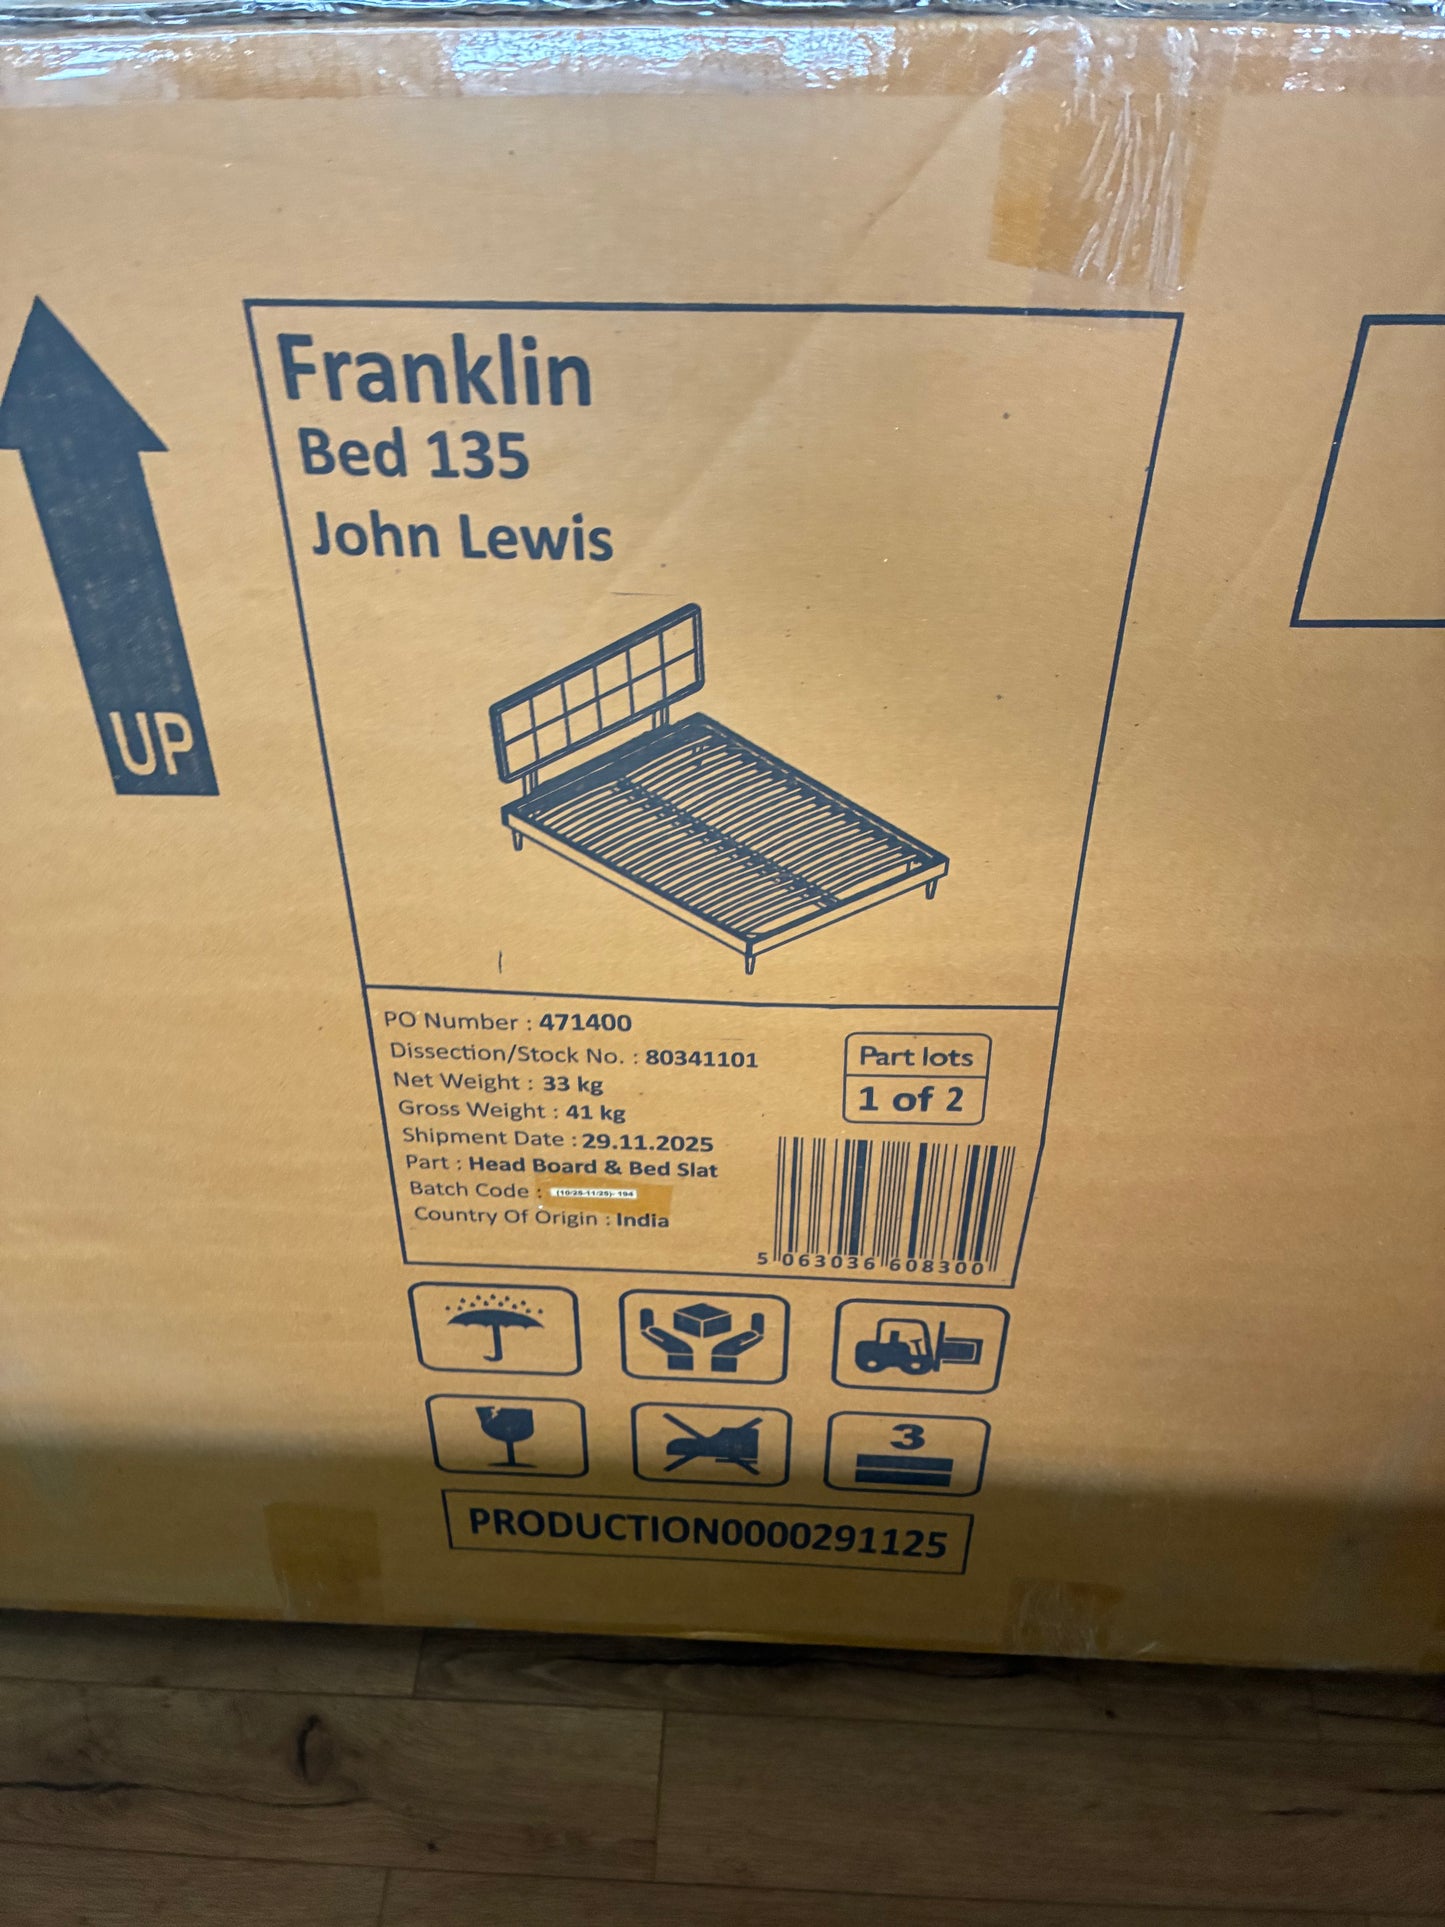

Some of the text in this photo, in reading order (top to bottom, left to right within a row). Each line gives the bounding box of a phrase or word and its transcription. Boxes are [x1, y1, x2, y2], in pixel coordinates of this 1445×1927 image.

[277, 332, 592, 406] Franklin
[298, 426, 529, 479] Bed 135
[312, 509, 614, 562] John Lewis
[109, 711, 193, 776] UP
[384, 1011, 416, 1028] PO
[424, 1012, 519, 1031] Number
[538, 1013, 632, 1033] 471400
[390, 1042, 579, 1064] Dissection/Stock
[586, 1049, 624, 1065] No.
[645, 1049, 759, 1068] 80341101
[860, 1045, 974, 1067] Part lots
[393, 1072, 434, 1089] Net
[441, 1073, 520, 1093] Weight
[542, 1075, 570, 1092] 33
[577, 1076, 604, 1096] kg
[859, 1085, 963, 1112] 1 of 2
[398, 1100, 461, 1117] Gross
[466, 1101, 546, 1122] Weight
[565, 1104, 593, 1120] 41
[600, 1104, 626, 1124] kg
[402, 1128, 508, 1149] Shipment
[514, 1131, 565, 1147] Date
[581, 1132, 714, 1152] 29.11.2025
[405, 1154, 450, 1171] Part
[469, 1155, 525, 1173] Head
[532, 1157, 598, 1175] Board
[604, 1160, 623, 1175] &
[629, 1161, 670, 1177] Bed
[677, 1161, 718, 1179] Slat
[409, 1180, 469, 1197] Batch
[475, 1182, 529, 1199] Code
[414, 1206, 497, 1226] Country
[504, 1209, 528, 1225] Of
[535, 1209, 598, 1228] Origin
[616, 1212, 669, 1228] India
[756, 1252, 984, 1275] 5 063036 608300
[890, 1424, 925, 1450] 3
[469, 1507, 948, 1559] PRODUCTION0000291125
